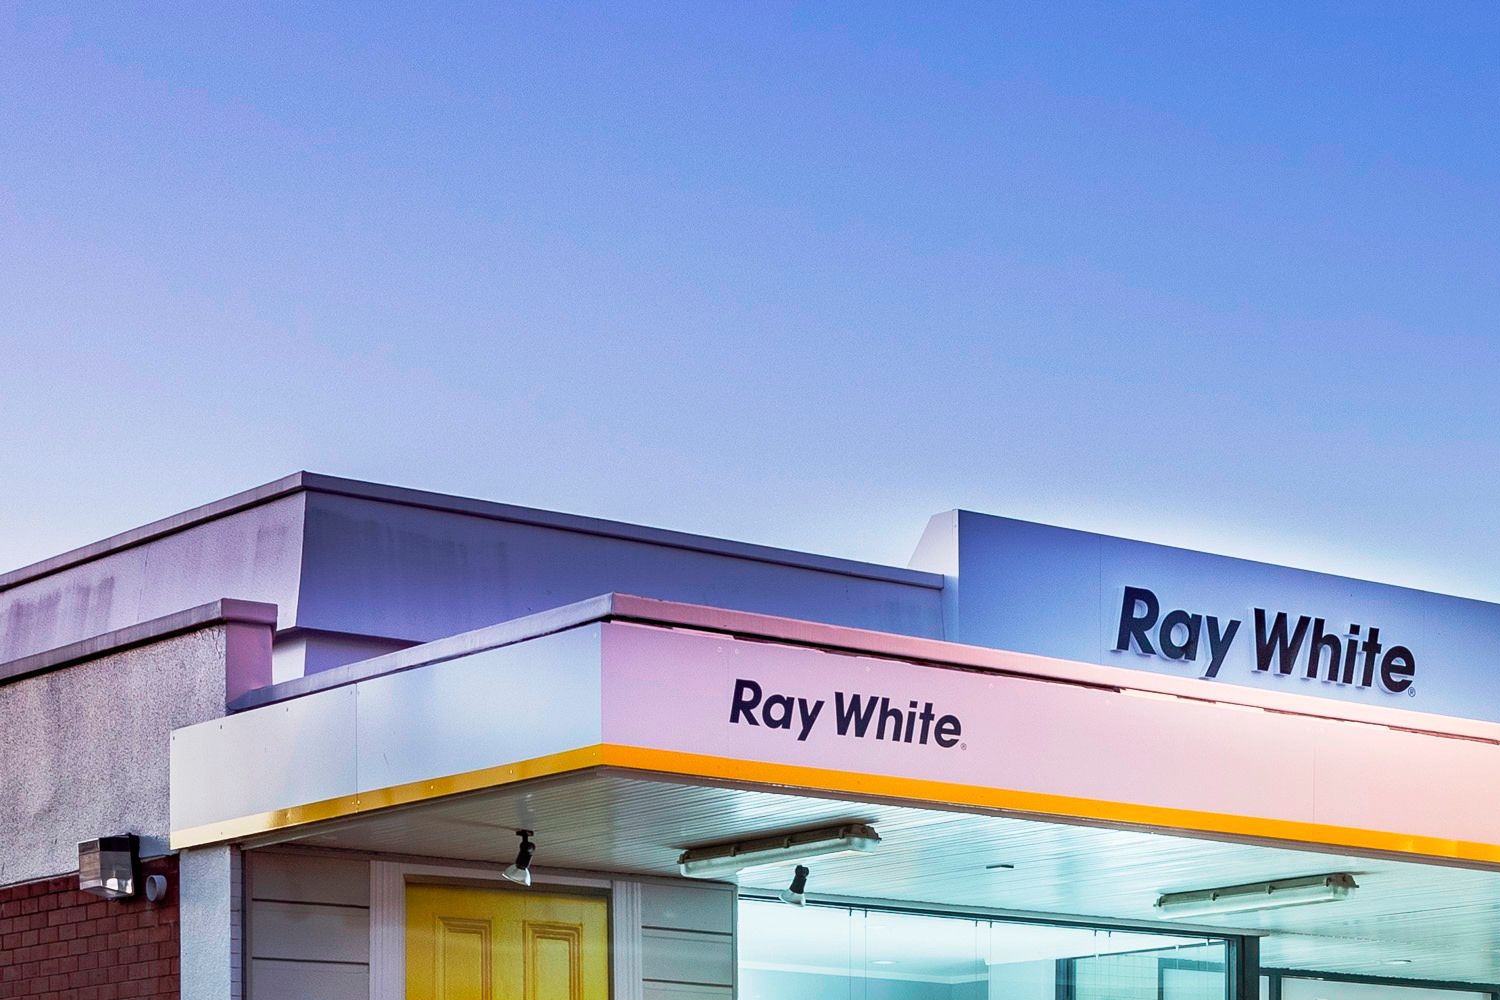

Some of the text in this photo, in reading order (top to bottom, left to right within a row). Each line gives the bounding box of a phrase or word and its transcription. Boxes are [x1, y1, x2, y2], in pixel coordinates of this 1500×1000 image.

[1114, 585, 1416, 693] Ray White
[728, 678, 962, 749] Ray White
